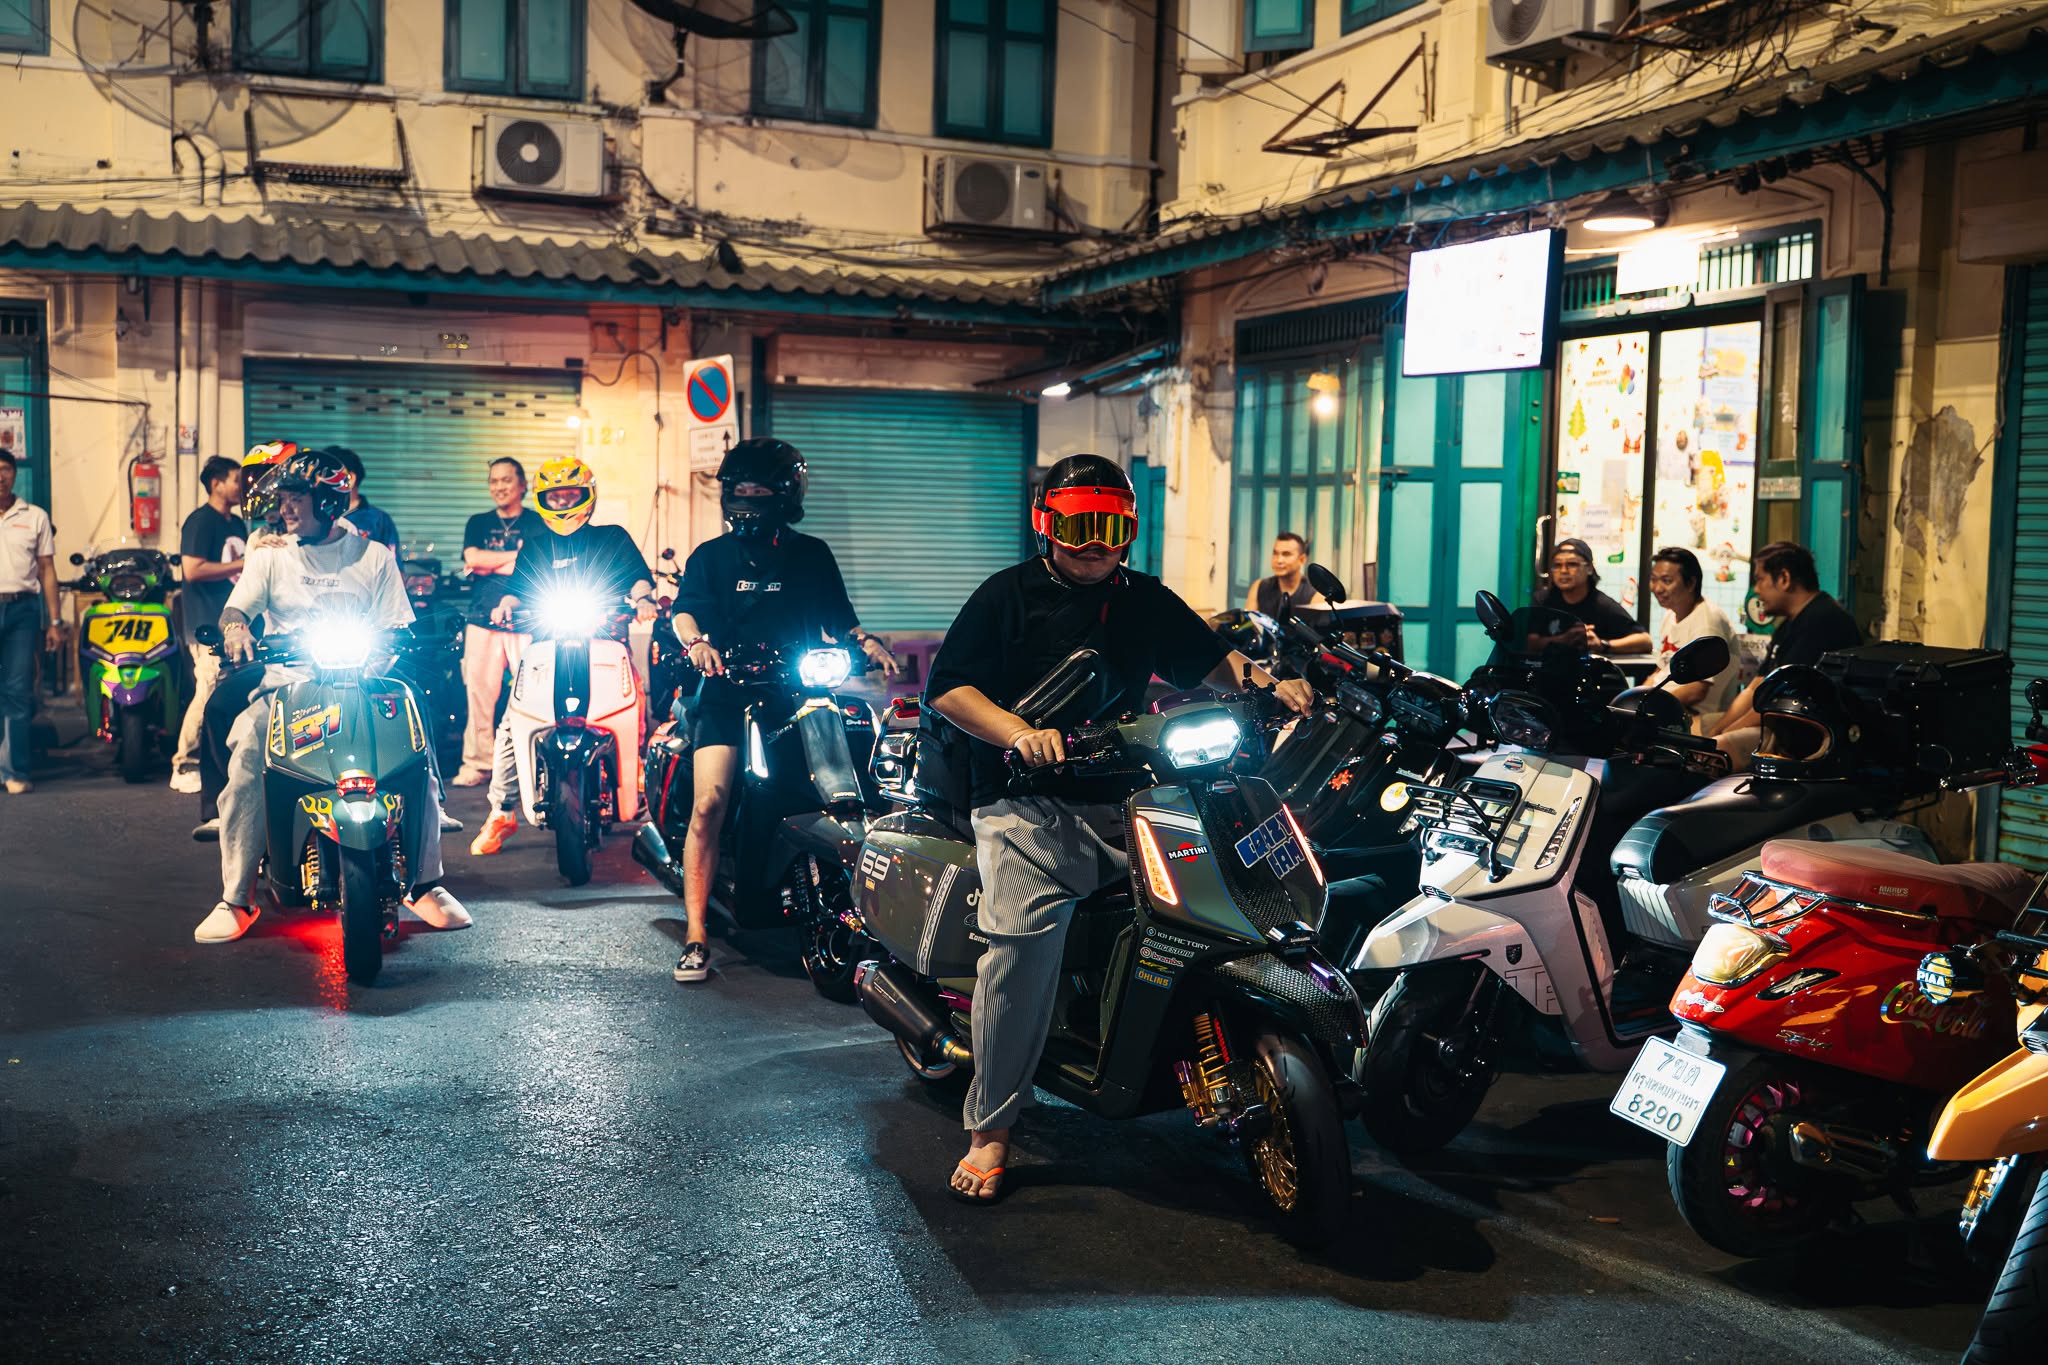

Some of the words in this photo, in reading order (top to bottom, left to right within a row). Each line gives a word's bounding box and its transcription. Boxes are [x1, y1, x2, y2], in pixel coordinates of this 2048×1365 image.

[104, 618, 153, 645] 748
[860, 849, 891, 881] 69
[1168, 846, 1208, 859] MARTINI
[1916, 968, 1946, 987] PIAA
[1628, 1093, 1682, 1132] 8290
